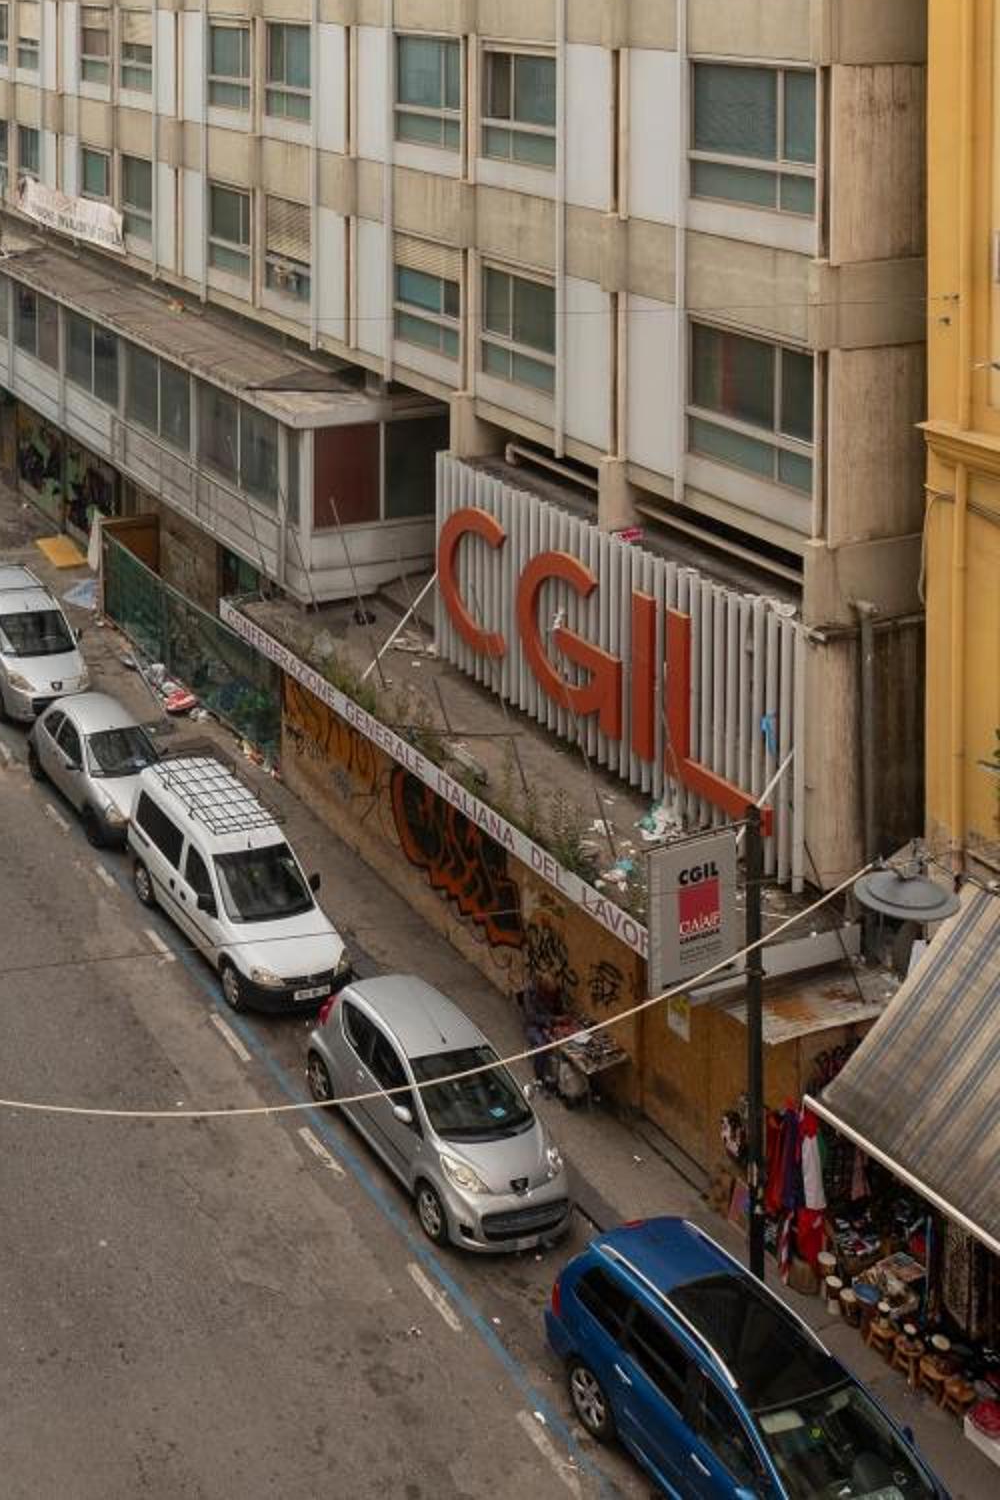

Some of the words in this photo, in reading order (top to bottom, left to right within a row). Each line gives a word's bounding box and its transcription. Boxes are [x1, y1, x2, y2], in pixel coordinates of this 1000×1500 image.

[437, 507, 773, 837] CGIL
[345, 702, 425, 780] GENERALE
[437, 772, 516, 851] ITALIANA
[530, 845, 567, 891] DEL
[678, 861, 719, 886] CGIL
